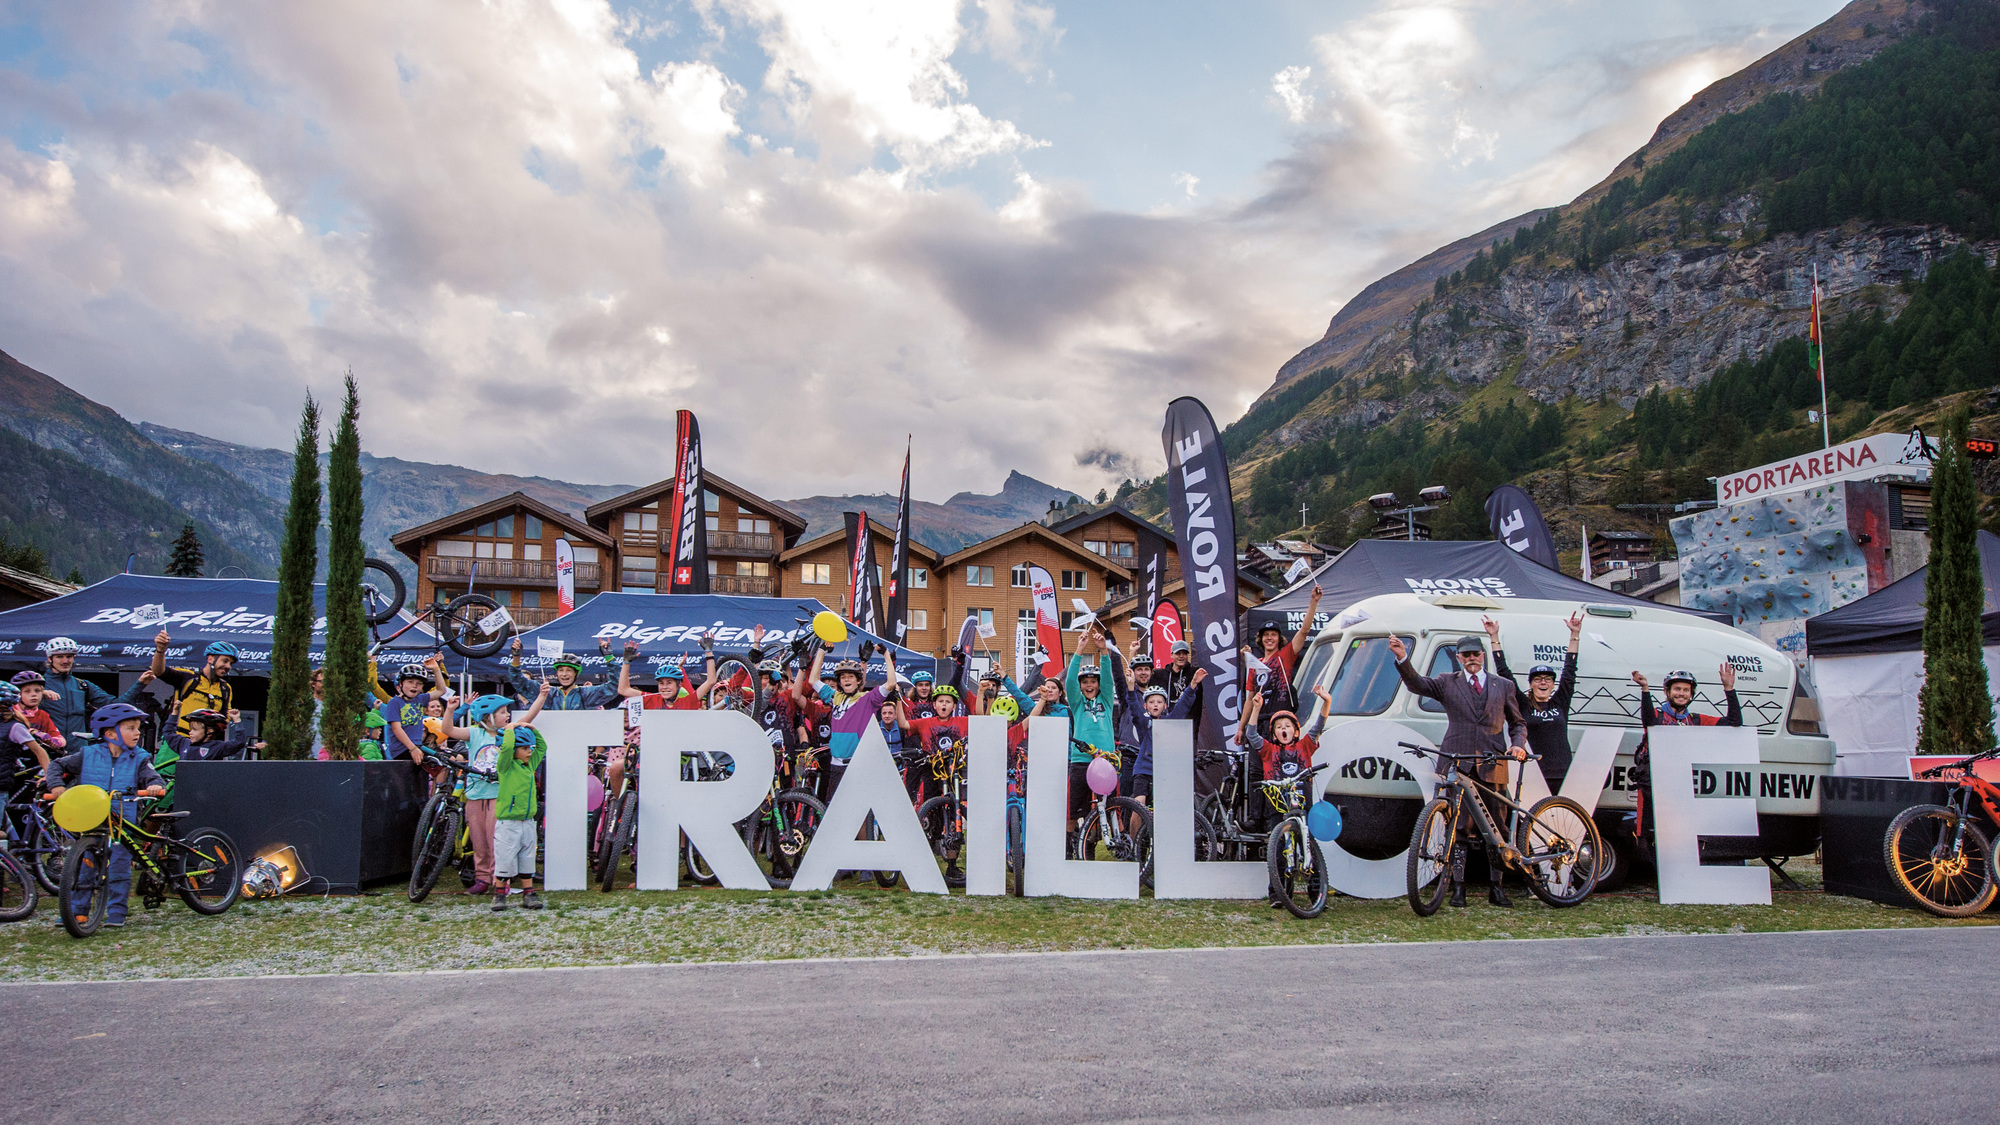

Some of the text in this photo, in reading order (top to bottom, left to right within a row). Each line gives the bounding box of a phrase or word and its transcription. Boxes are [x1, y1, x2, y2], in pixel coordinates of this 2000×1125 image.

[1722, 443, 1878, 500] SPORTARENA
[1404, 577, 1506, 590] MONS
[1033, 586, 1054, 597] SWISS
[1286, 612, 1330, 621] MONS
[1287, 622, 1330, 631] ROALE
[1533, 644, 1569, 654] MONS
[1534, 653, 1566, 663] ROYAL
[1726, 654, 1761, 664] MONS
[1341, 756, 1417, 782] ROYA
[1725, 771, 1752, 797] IN
[1760, 772, 1815, 800] NEW
